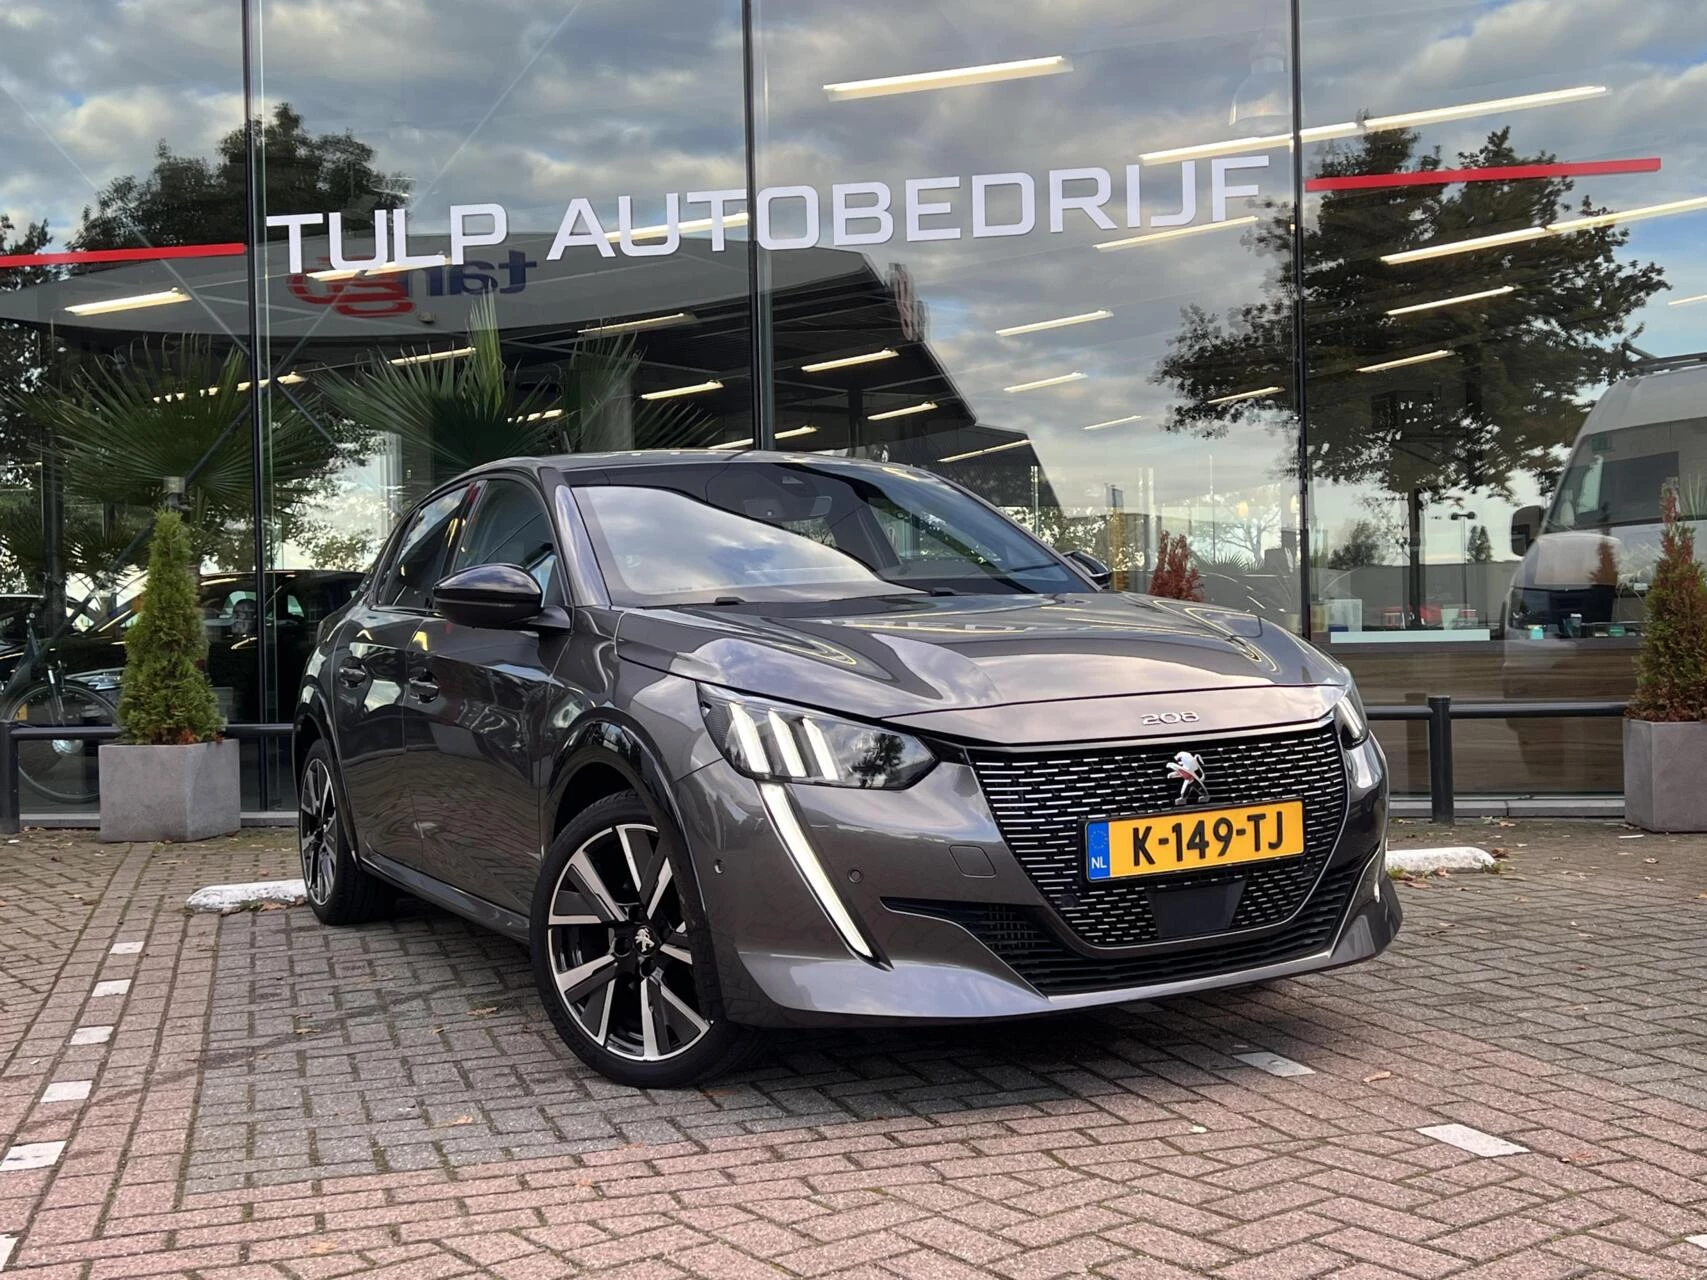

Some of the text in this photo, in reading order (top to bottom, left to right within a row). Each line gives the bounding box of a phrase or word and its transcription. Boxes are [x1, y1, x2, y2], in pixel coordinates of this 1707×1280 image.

[266, 155, 1270, 274] TULP AUTOBEDRIJF
[1140, 711, 1200, 726] 208
[1132, 811, 1283, 867] K-149-TJ
[1091, 857, 1107, 869] NL
